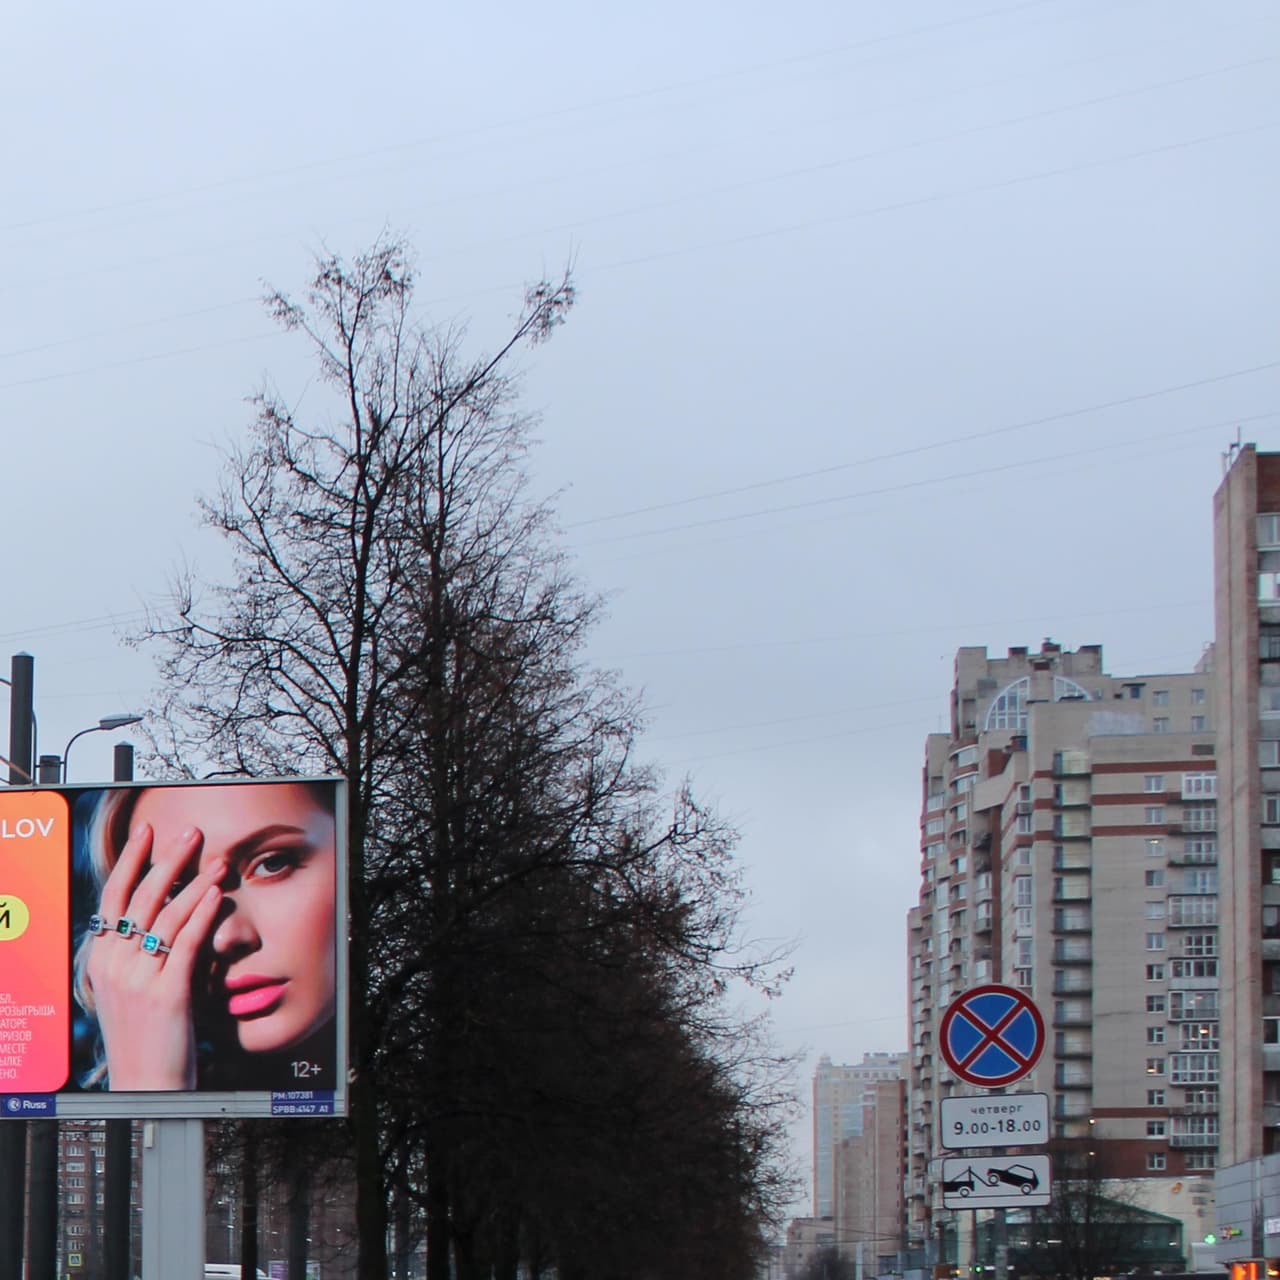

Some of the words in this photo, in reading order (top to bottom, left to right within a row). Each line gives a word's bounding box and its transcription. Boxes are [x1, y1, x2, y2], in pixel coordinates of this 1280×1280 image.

[0, 1004, 56, 1017] РОЗЫГРЫША
[0, 1042, 27, 1054] МЕСТЕ
[290, 1061, 322, 1078] 12+
[23, 1100, 47, 1110] Russ
[970, 1104, 1024, 1115] четверг
[953, 1119, 1041, 1135] 9.00-18.00
